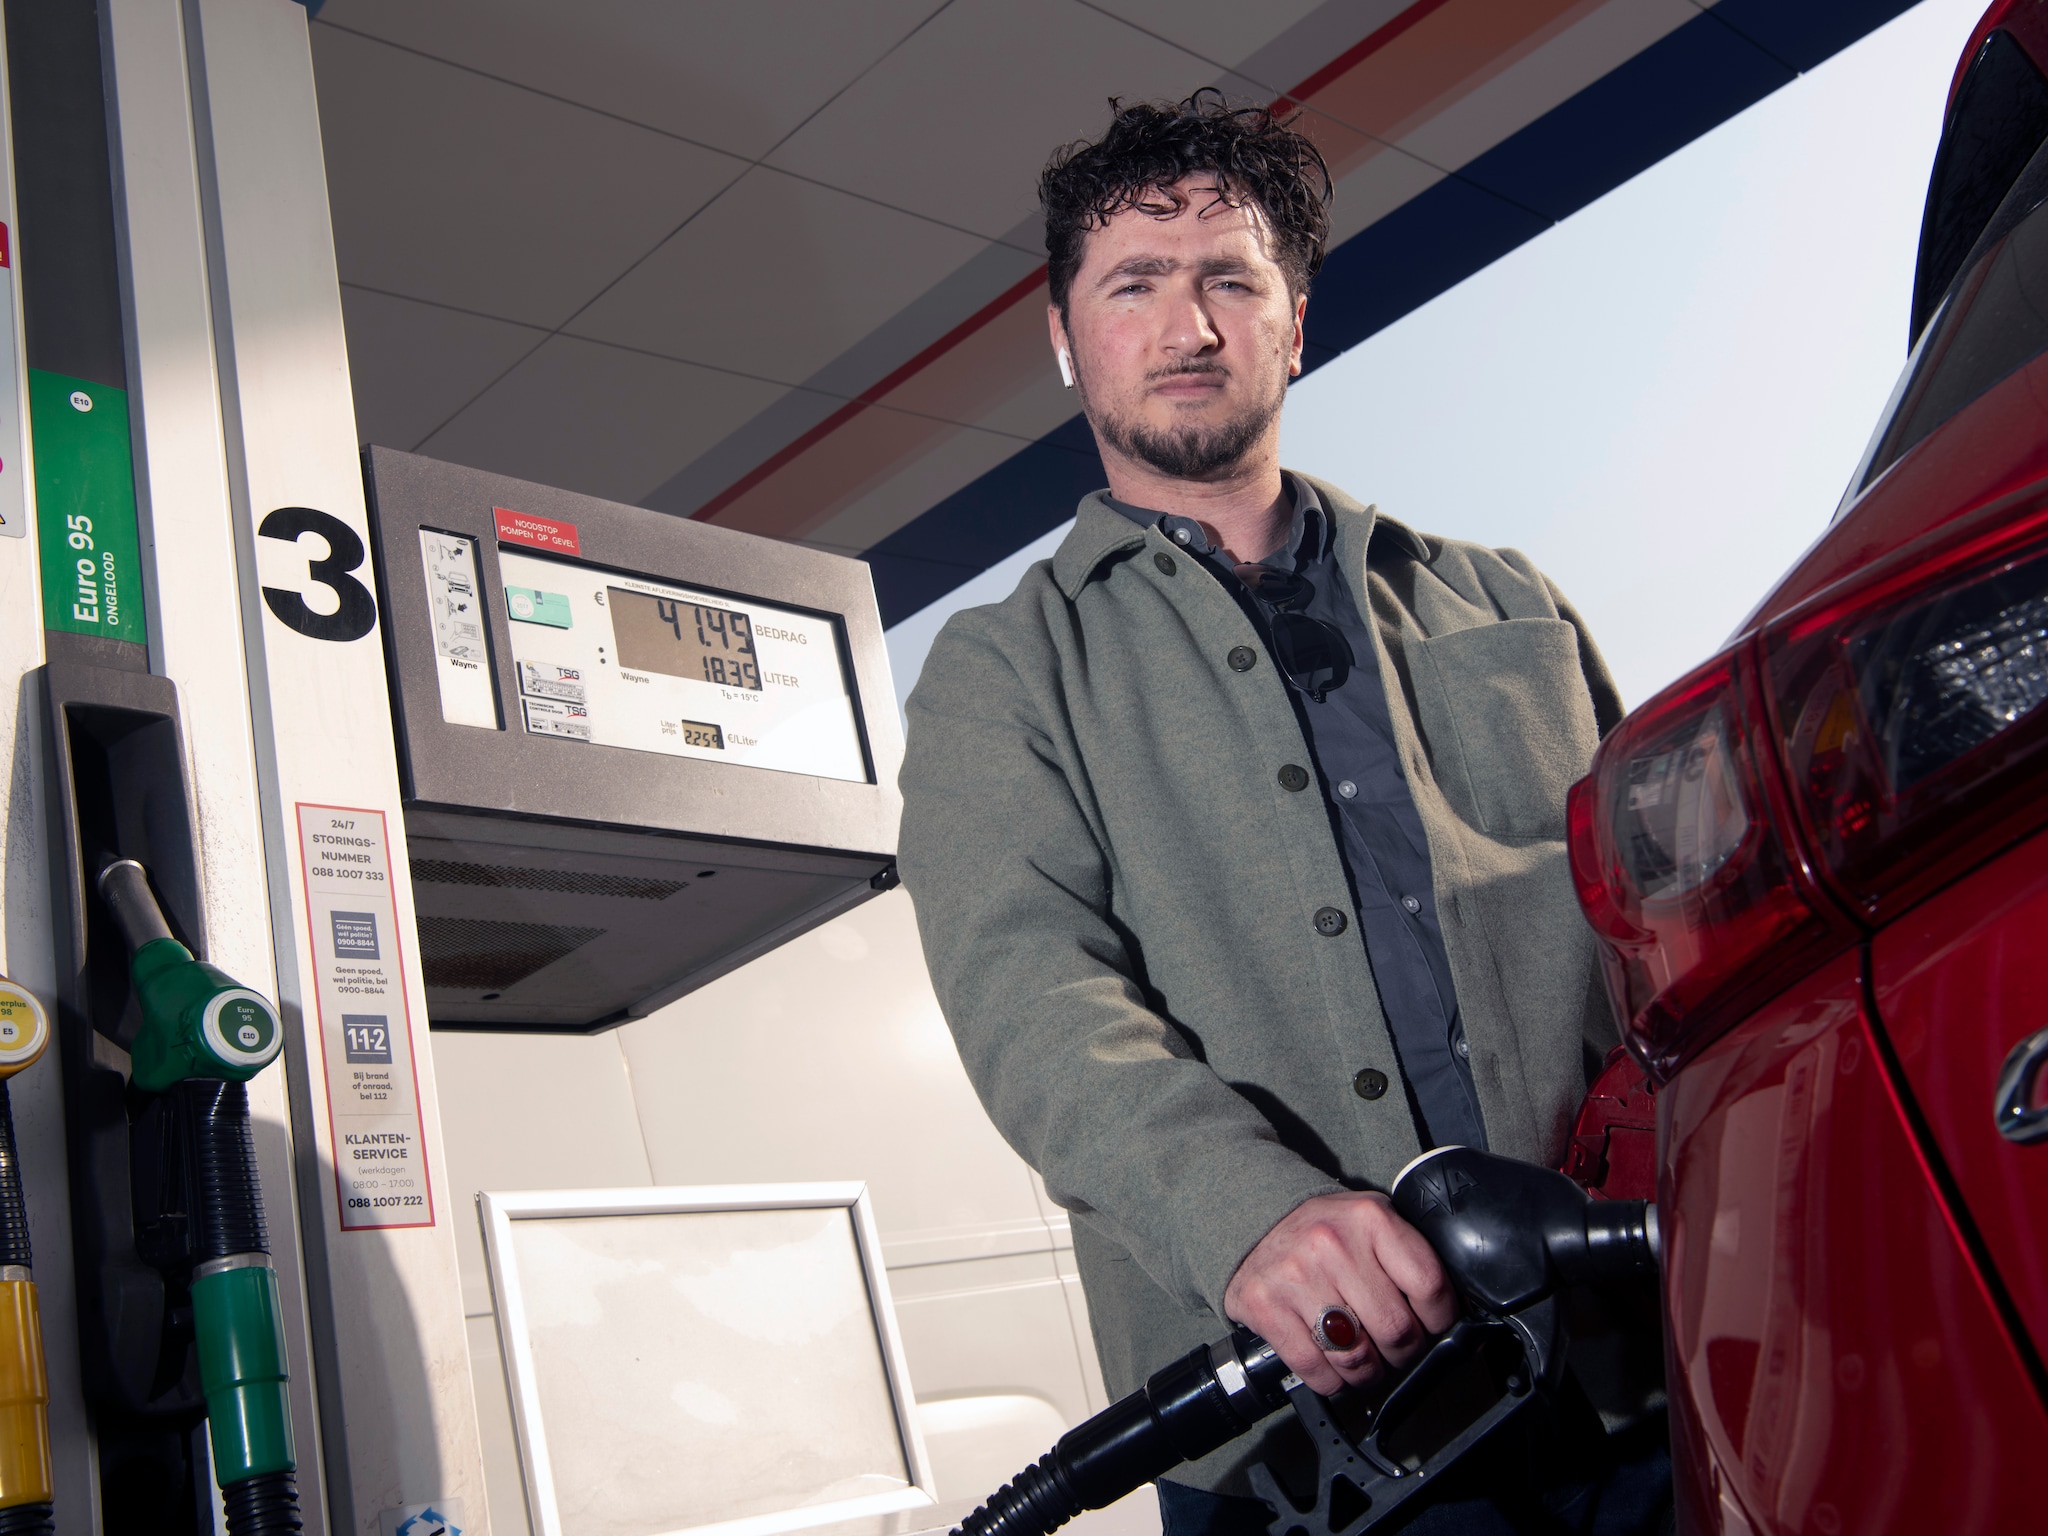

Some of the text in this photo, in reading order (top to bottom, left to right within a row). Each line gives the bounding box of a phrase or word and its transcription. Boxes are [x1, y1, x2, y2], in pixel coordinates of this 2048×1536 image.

[74, 397, 89, 407] E10
[515, 519, 559, 535] NOODSTOP
[500, 525, 575, 548] POMPEN OP GEVEL
[67, 514, 100, 623] Euro 95
[258, 506, 376, 642] 3
[103, 552, 119, 626] ONGELOOD
[594, 591, 605, 606] €
[755, 624, 808, 645] BEDRAG
[450, 658, 478, 670] Wayne
[556, 667, 580, 680] TSG
[620, 671, 650, 684] Wayne
[763, 671, 800, 688] LITER
[565, 705, 587, 717] TSG
[727, 732, 758, 747] €/Liter
[331, 819, 355, 830] 24/7
[312, 833, 376, 848] STORINGS-
[321, 850, 371, 864] NUMMER
[312, 867, 384, 881] 088 1007 333
[337, 938, 375, 947] 0900-8844
[335, 966, 383, 976] Geen spoed,
[348, 976, 375, 985] politie,
[338, 986, 385, 995] 0900-8844
[0, 1000, 27, 1008] erplus
[237, 1006, 255, 1014] Euro
[1, 1008, 12, 1016] 98
[3, 1027, 14, 1035] E5
[243, 1032, 256, 1040] E10
[347, 1027, 387, 1050] 1-1-2
[353, 1072, 389, 1081] Bij brand
[352, 1082, 393, 1090] of onraad,
[360, 1092, 388, 1100] bel 112
[345, 1133, 411, 1145] KLANTEN-
[353, 1148, 408, 1160] SERVICE
[358, 1166, 406, 1175] (werkdagen
[352, 1180, 379, 1189] 08:00
[348, 1195, 423, 1208] 088 1007 222
